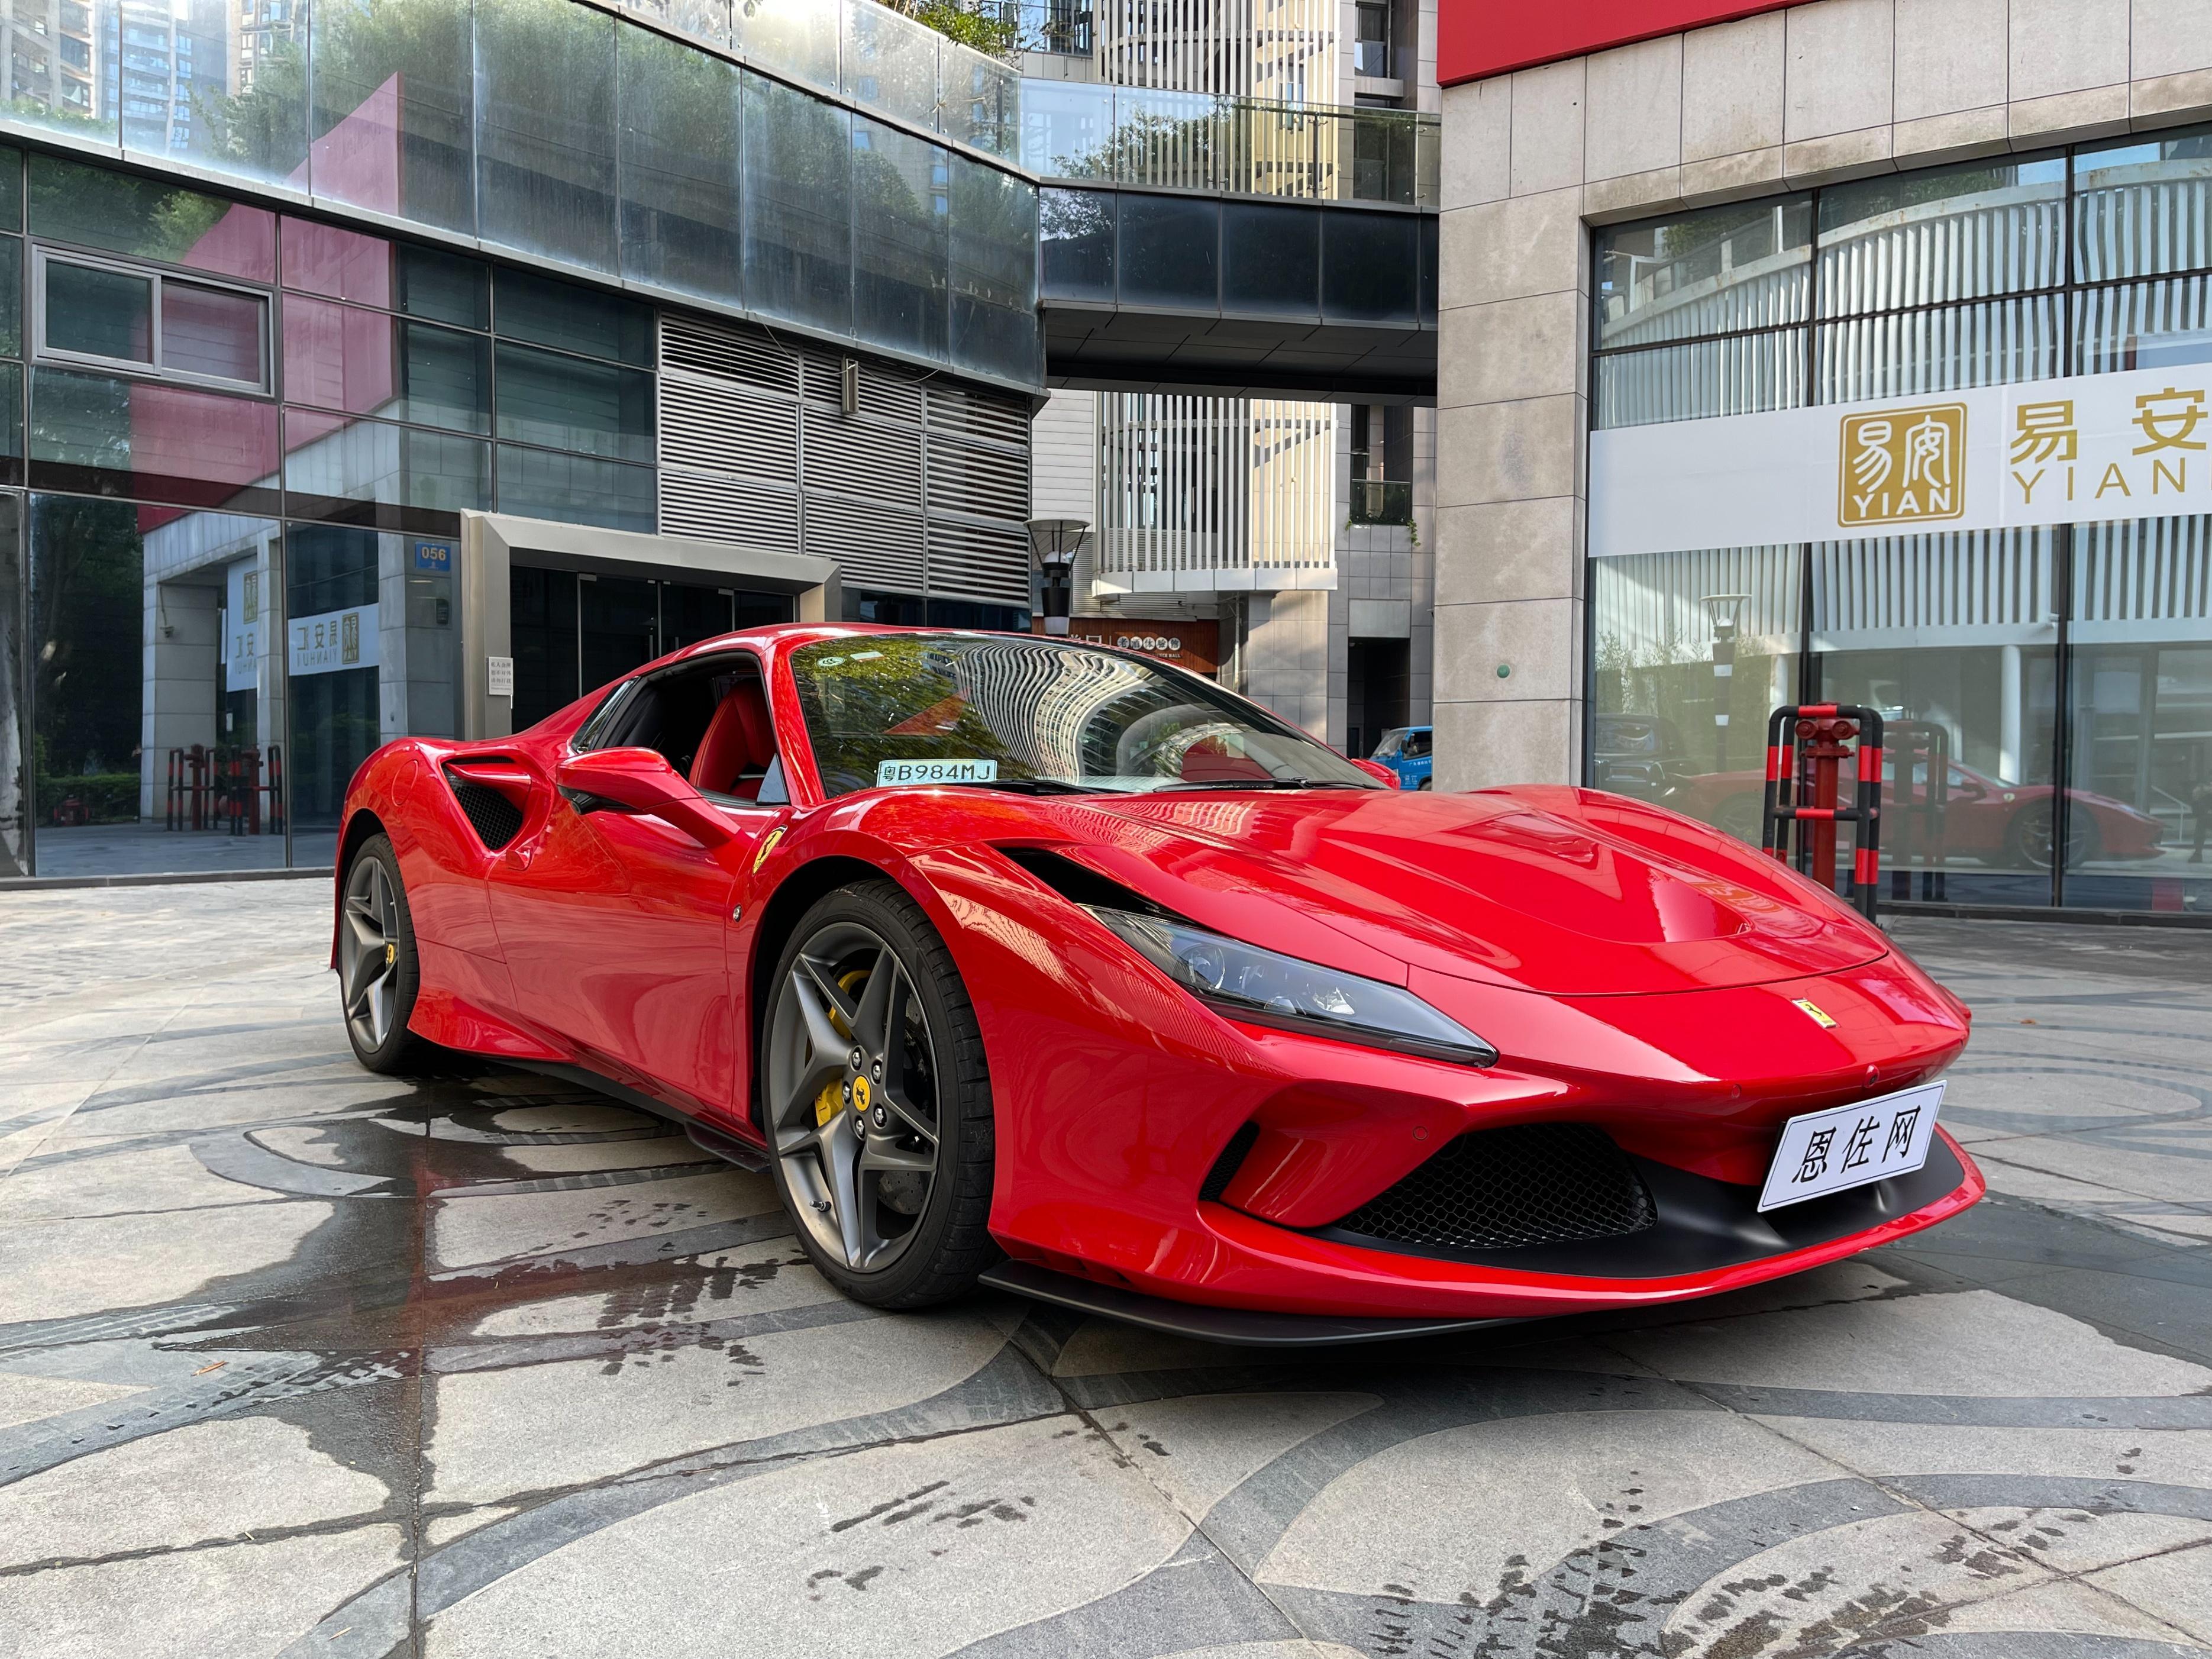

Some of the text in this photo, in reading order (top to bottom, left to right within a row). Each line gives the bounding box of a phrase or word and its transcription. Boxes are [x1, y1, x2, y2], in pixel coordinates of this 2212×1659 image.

[2010, 388, 2208, 465] 易安
[1852, 487, 1951, 518] YIAN
[2011, 457, 2212, 504] YIAN
[421, 546, 446, 561] 056
[1791, 1104, 1922, 1183] 恩佐网
